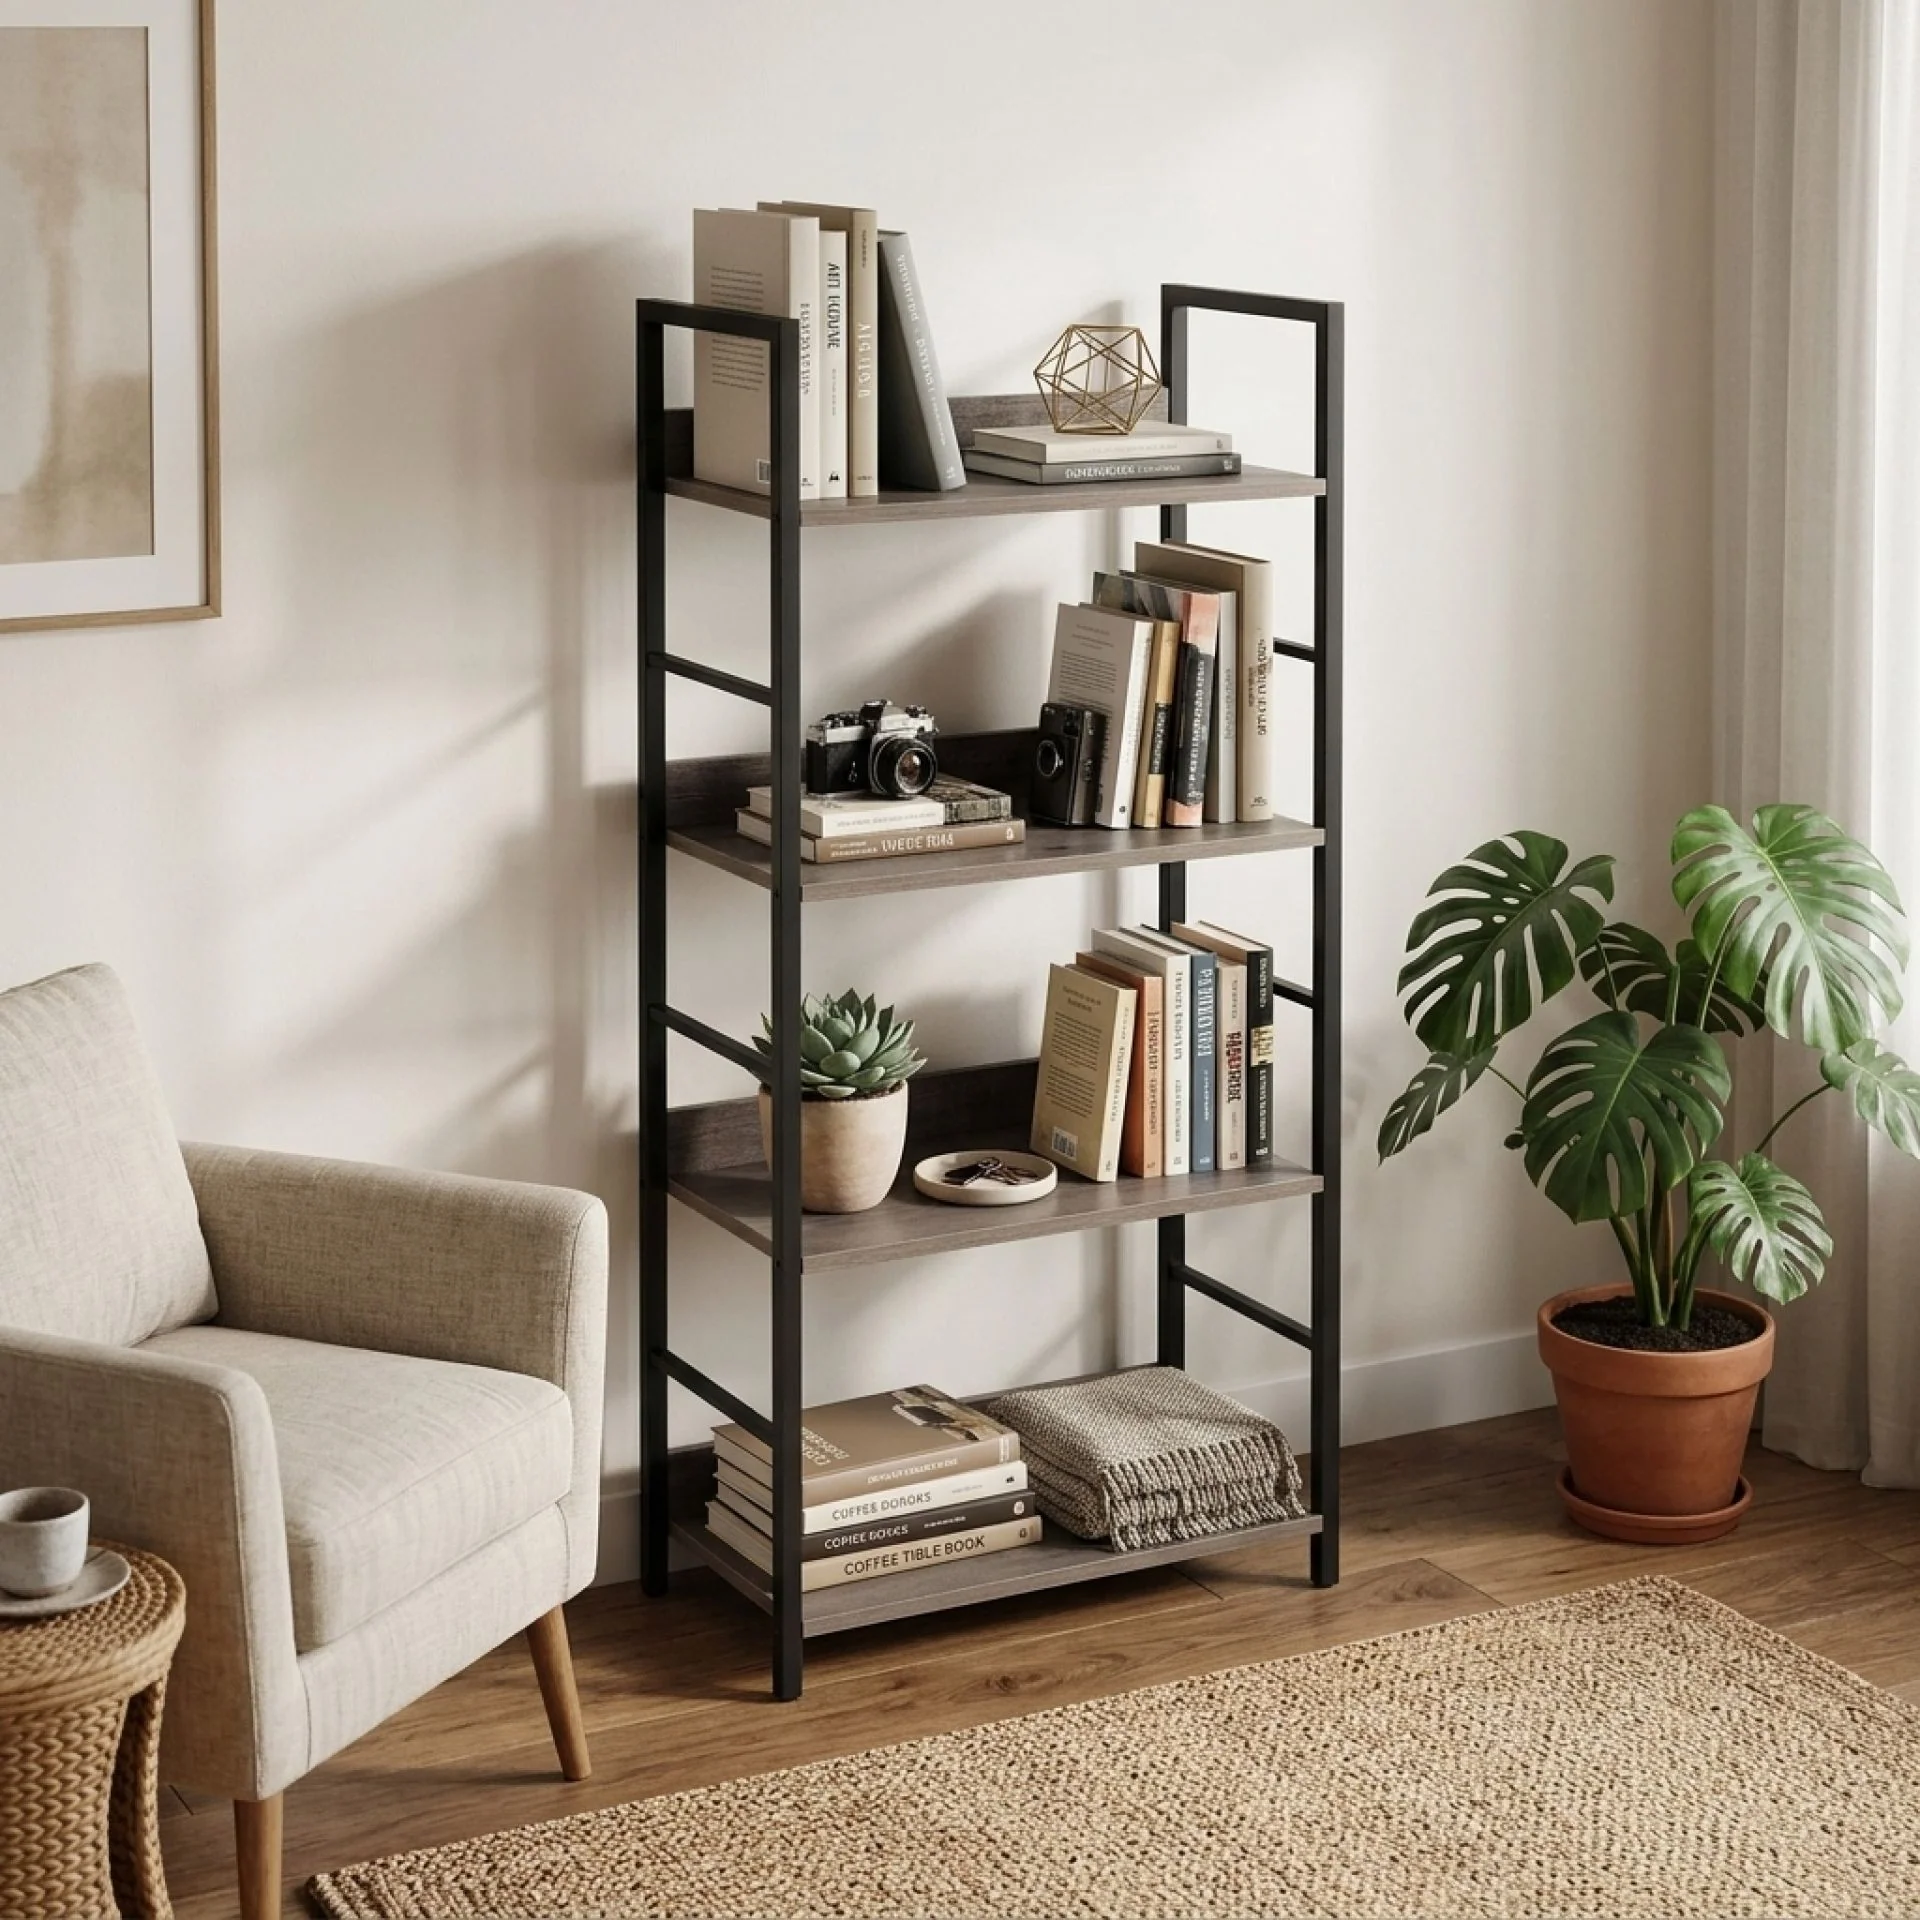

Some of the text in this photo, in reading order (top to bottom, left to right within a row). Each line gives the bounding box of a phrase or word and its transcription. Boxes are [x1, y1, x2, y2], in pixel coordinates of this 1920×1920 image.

[844, 1535, 985, 1575] COFFEE TIBLE BOOK
